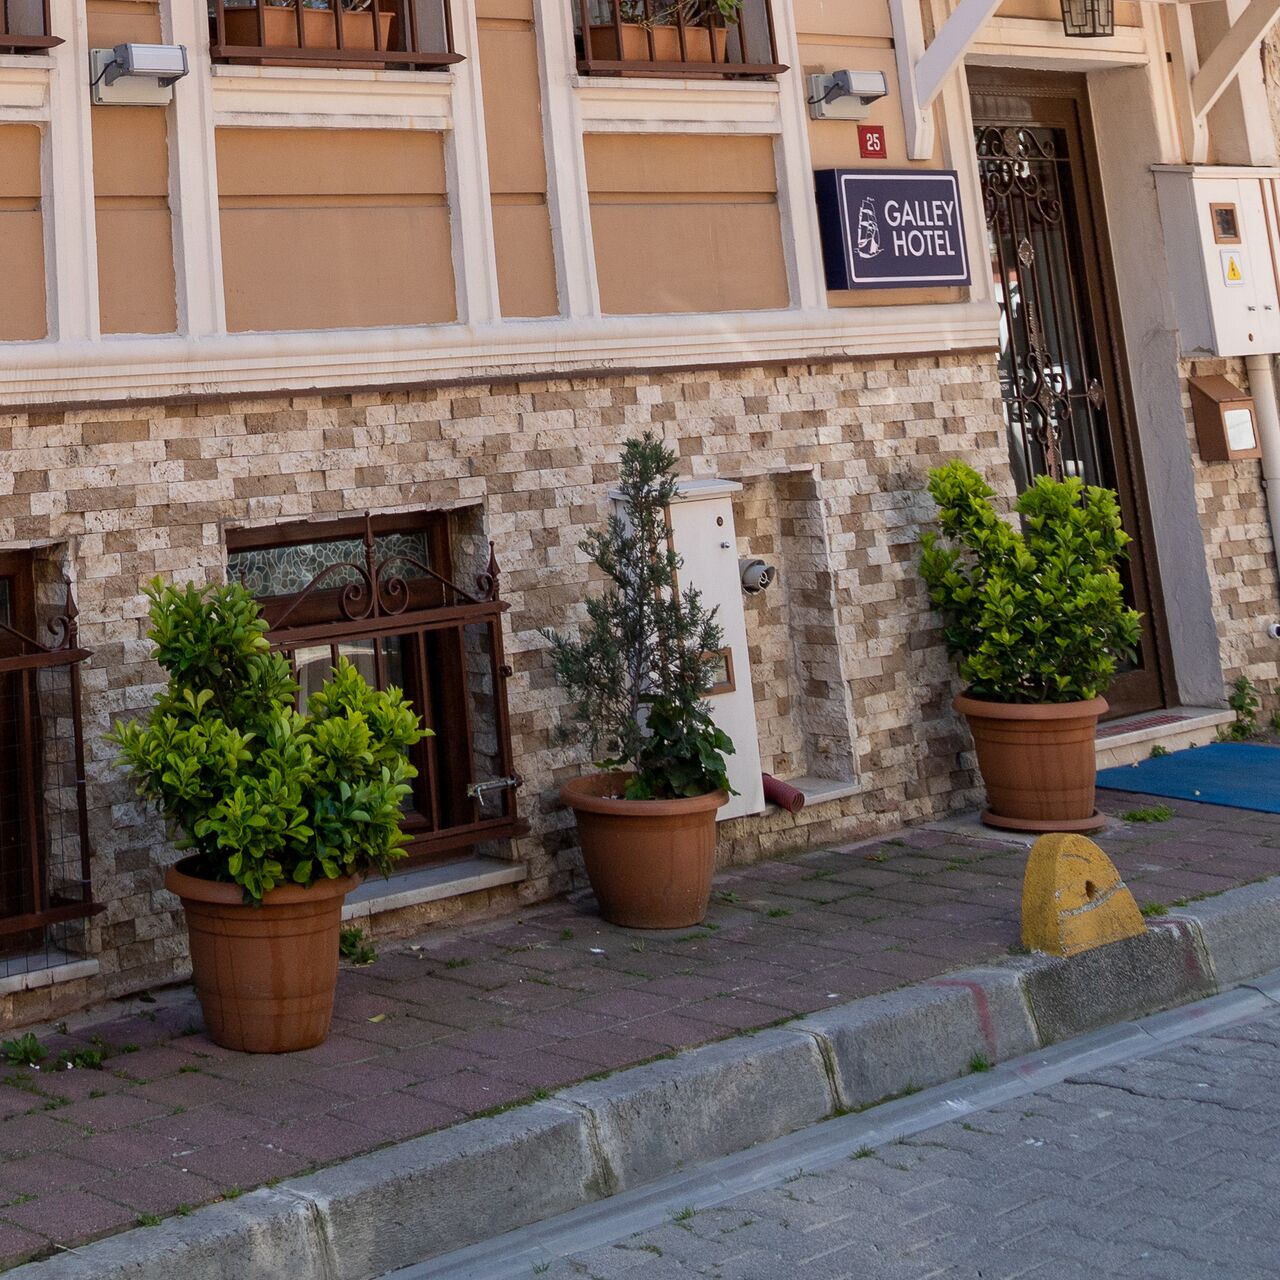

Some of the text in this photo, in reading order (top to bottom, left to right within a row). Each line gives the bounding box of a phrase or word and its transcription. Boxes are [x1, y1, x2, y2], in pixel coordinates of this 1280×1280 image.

[866, 133, 881, 151] 25
[884, 200, 955, 227] GALLEY
[892, 230, 956, 257] HOTEL
